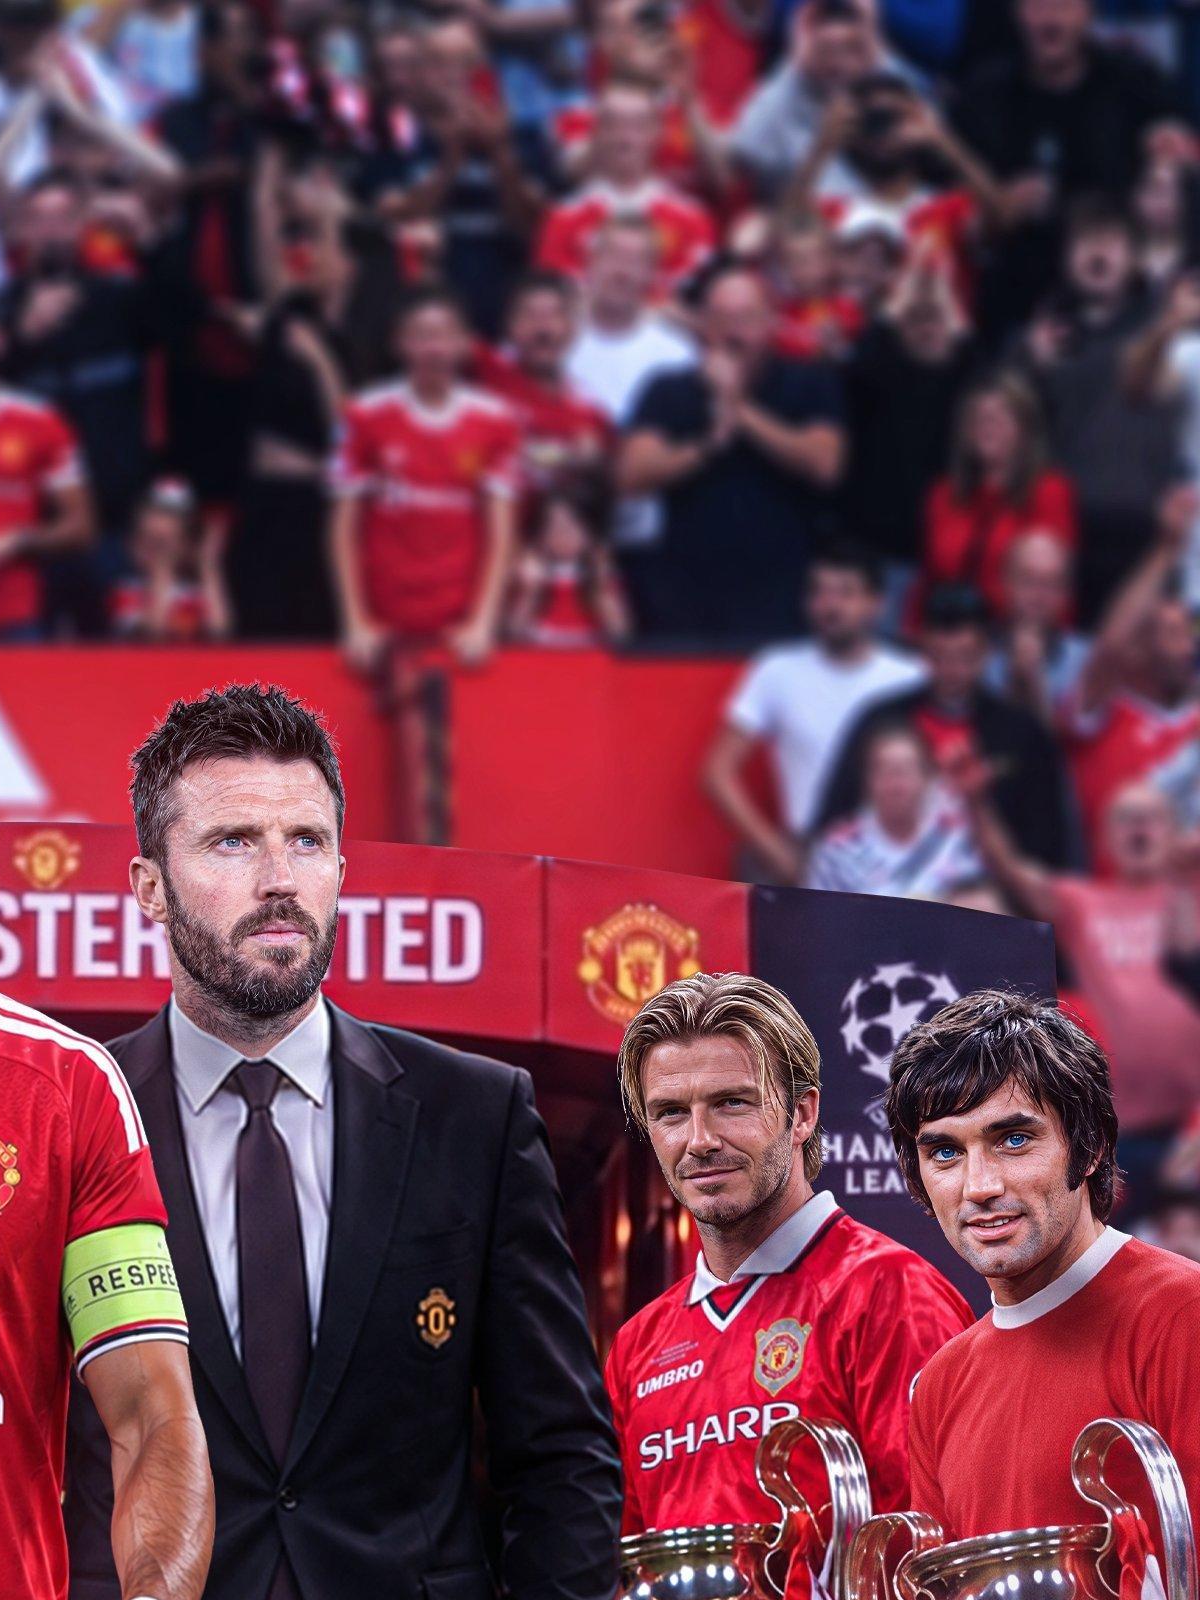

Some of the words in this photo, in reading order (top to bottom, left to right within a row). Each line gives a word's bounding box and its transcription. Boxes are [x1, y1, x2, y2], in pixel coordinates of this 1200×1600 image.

[337, 896, 483, 983] TED
[821, 1133, 899, 1162] HAM
[845, 1168, 904, 1194] LEA
[637, 1359, 705, 1399] UMBRO
[639, 1401, 800, 1470] SHARP
